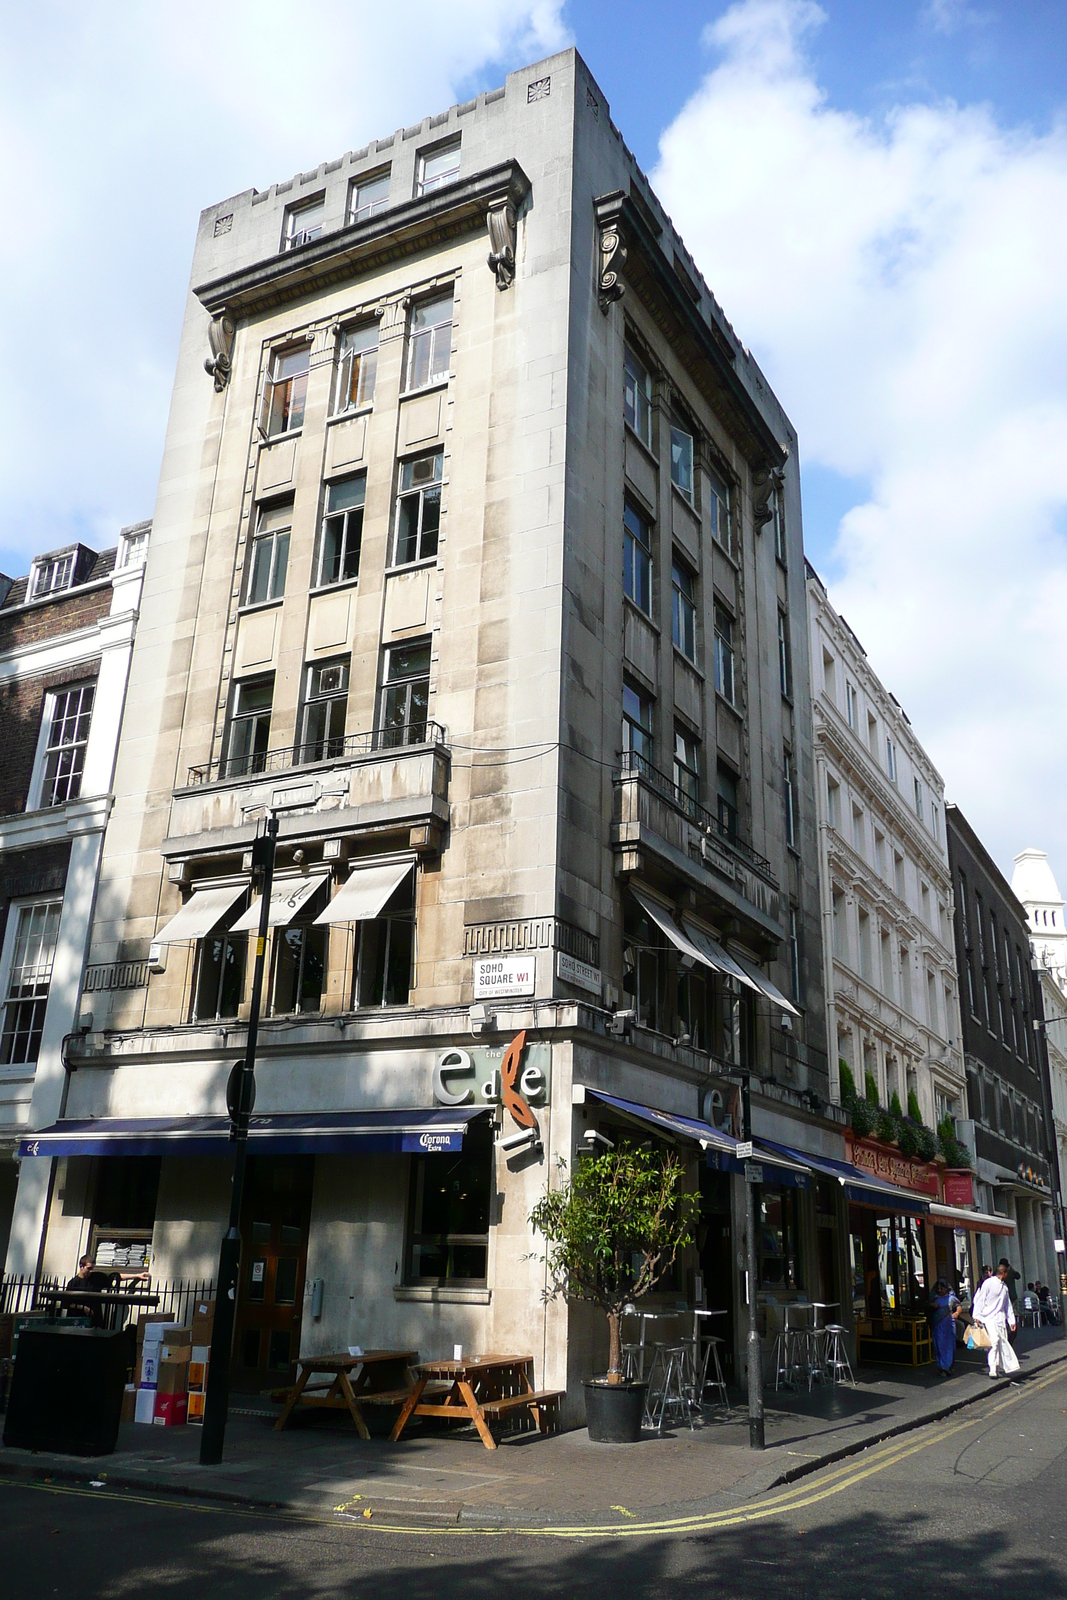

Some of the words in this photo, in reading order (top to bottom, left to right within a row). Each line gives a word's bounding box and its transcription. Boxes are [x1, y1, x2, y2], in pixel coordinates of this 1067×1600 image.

[480, 963, 503, 974] SOHO
[562, 957, 575, 971] SOHO
[576, 963, 592, 979] STREET
[592, 971, 600, 983] W1
[480, 974, 514, 985] SQUARE
[517, 972, 529, 982] W1
[420, 1134, 451, 1148] Corona
[427, 1144, 442, 1152] Extra
